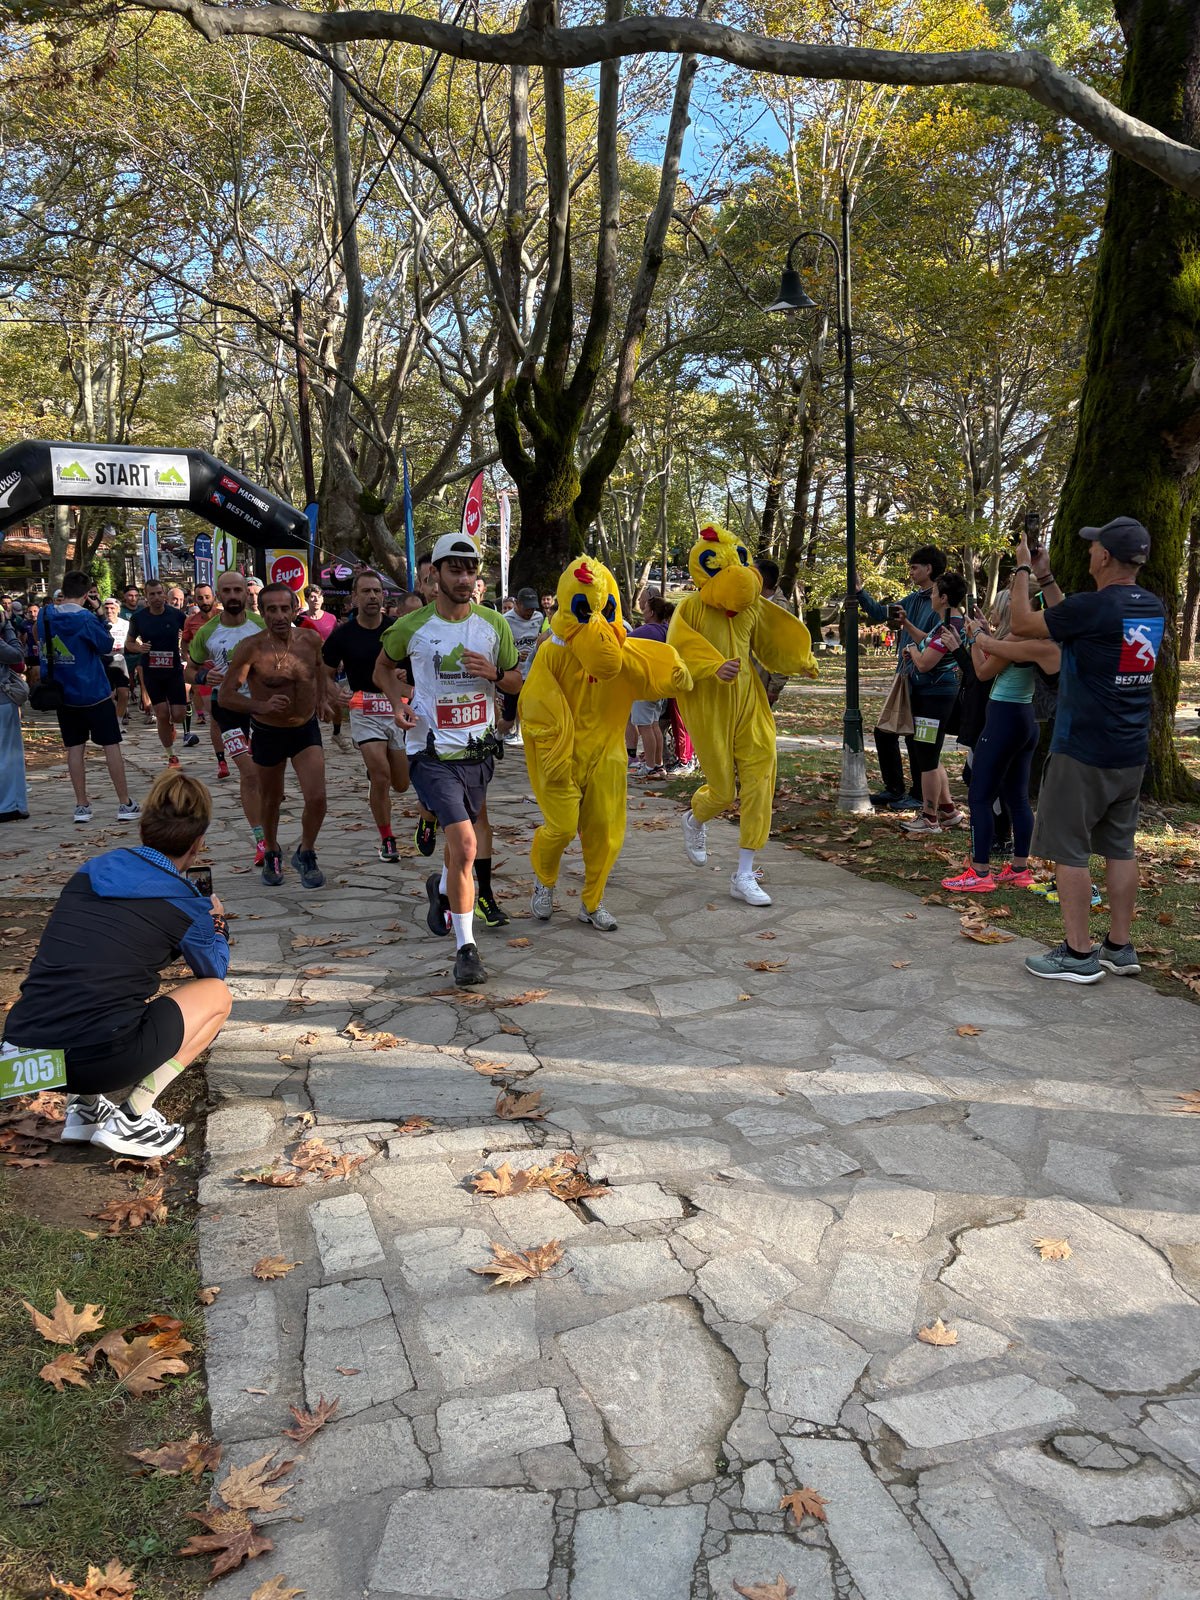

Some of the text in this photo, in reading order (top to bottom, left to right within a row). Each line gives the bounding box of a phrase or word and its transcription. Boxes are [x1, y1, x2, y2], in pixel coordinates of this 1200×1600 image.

[95, 462, 150, 486] START
[238, 488, 270, 512] MACHINES
[226, 502, 262, 528] BEST RACE
[155, 657, 170, 666] 342
[1115, 675, 1138, 685] BEST
[372, 701, 393, 712] 395
[451, 705, 480, 724] 386
[12, 1054, 54, 1087] 205
